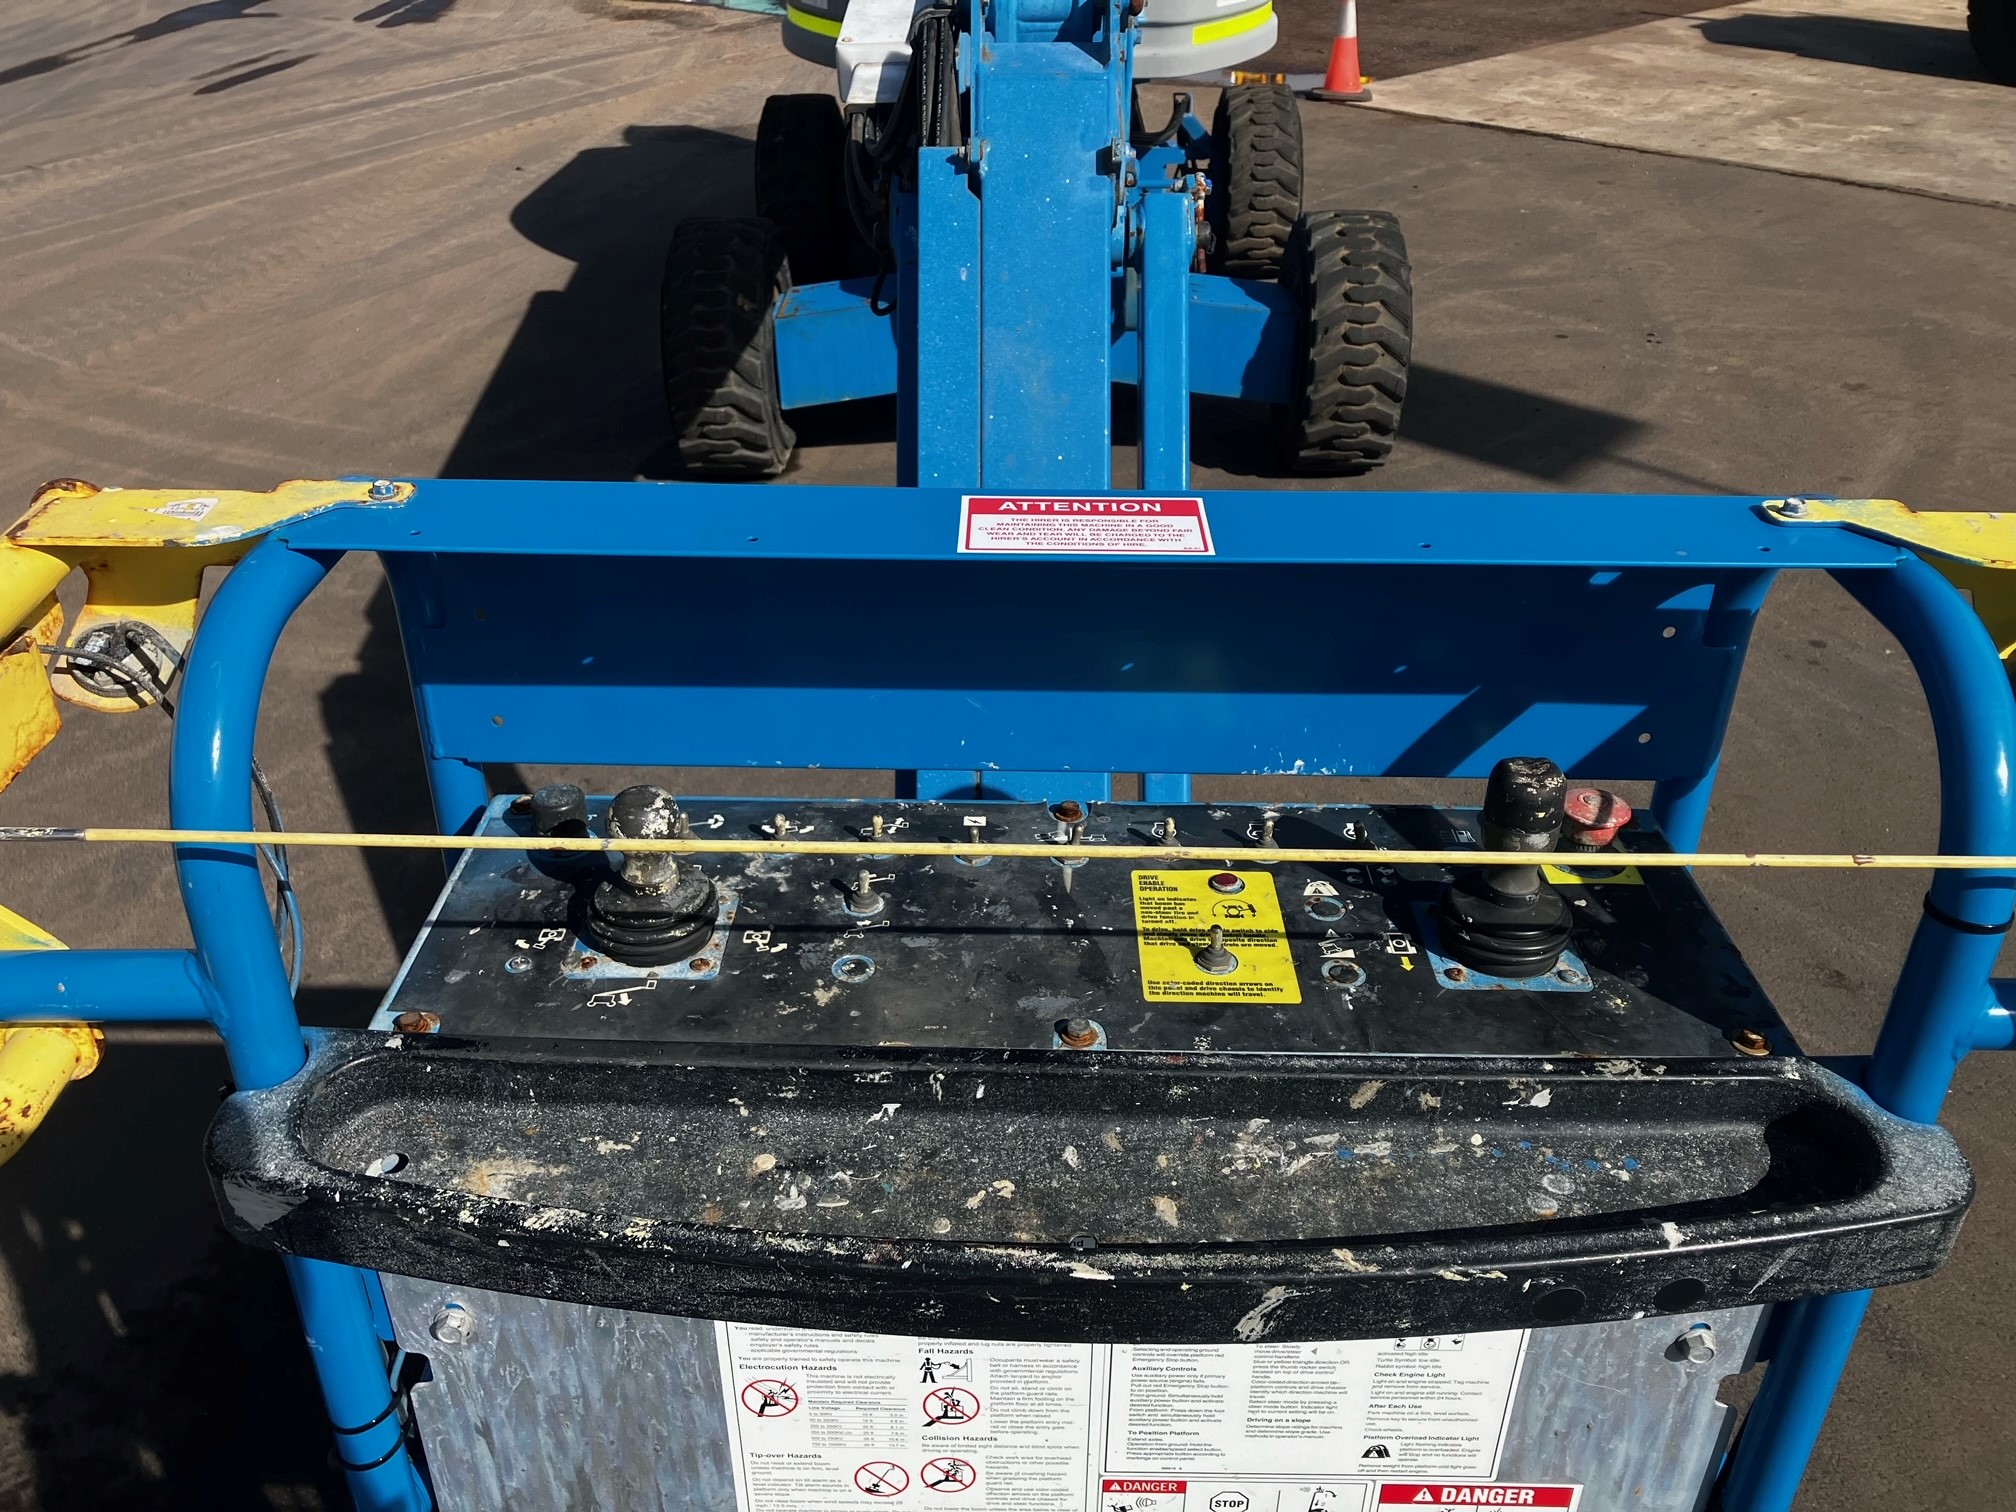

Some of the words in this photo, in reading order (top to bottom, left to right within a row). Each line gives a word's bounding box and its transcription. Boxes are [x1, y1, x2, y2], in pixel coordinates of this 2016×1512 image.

[998, 502, 1162, 512] ATTENTION
[1124, 1482, 1177, 1491] DANGER
[1441, 1488, 1534, 1504] DANGER
